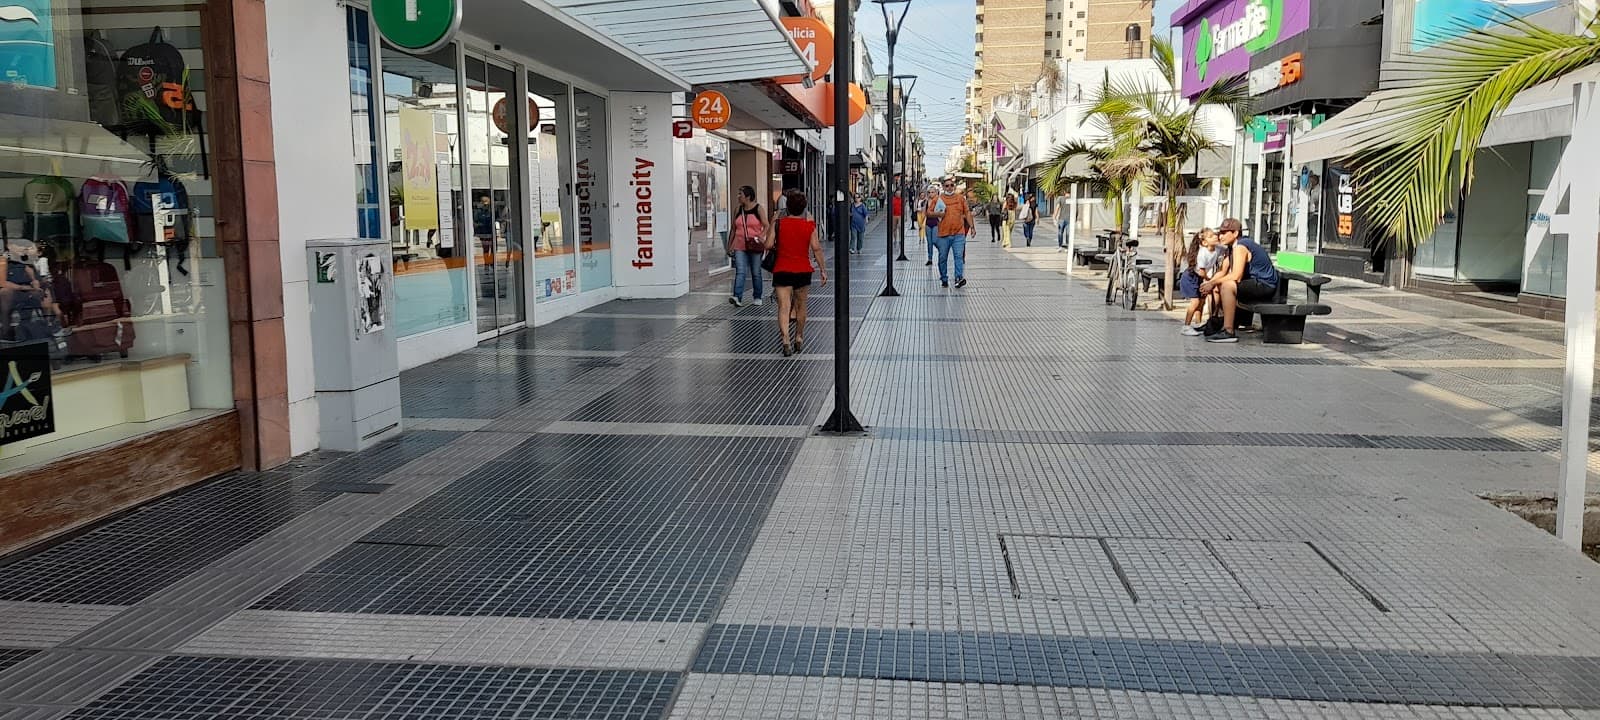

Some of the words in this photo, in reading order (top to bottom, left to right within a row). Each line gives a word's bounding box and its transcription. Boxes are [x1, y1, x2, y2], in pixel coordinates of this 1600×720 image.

[699, 97, 723, 115] 24
[698, 116, 723, 124] horas
[630, 157, 655, 270] farmacity
